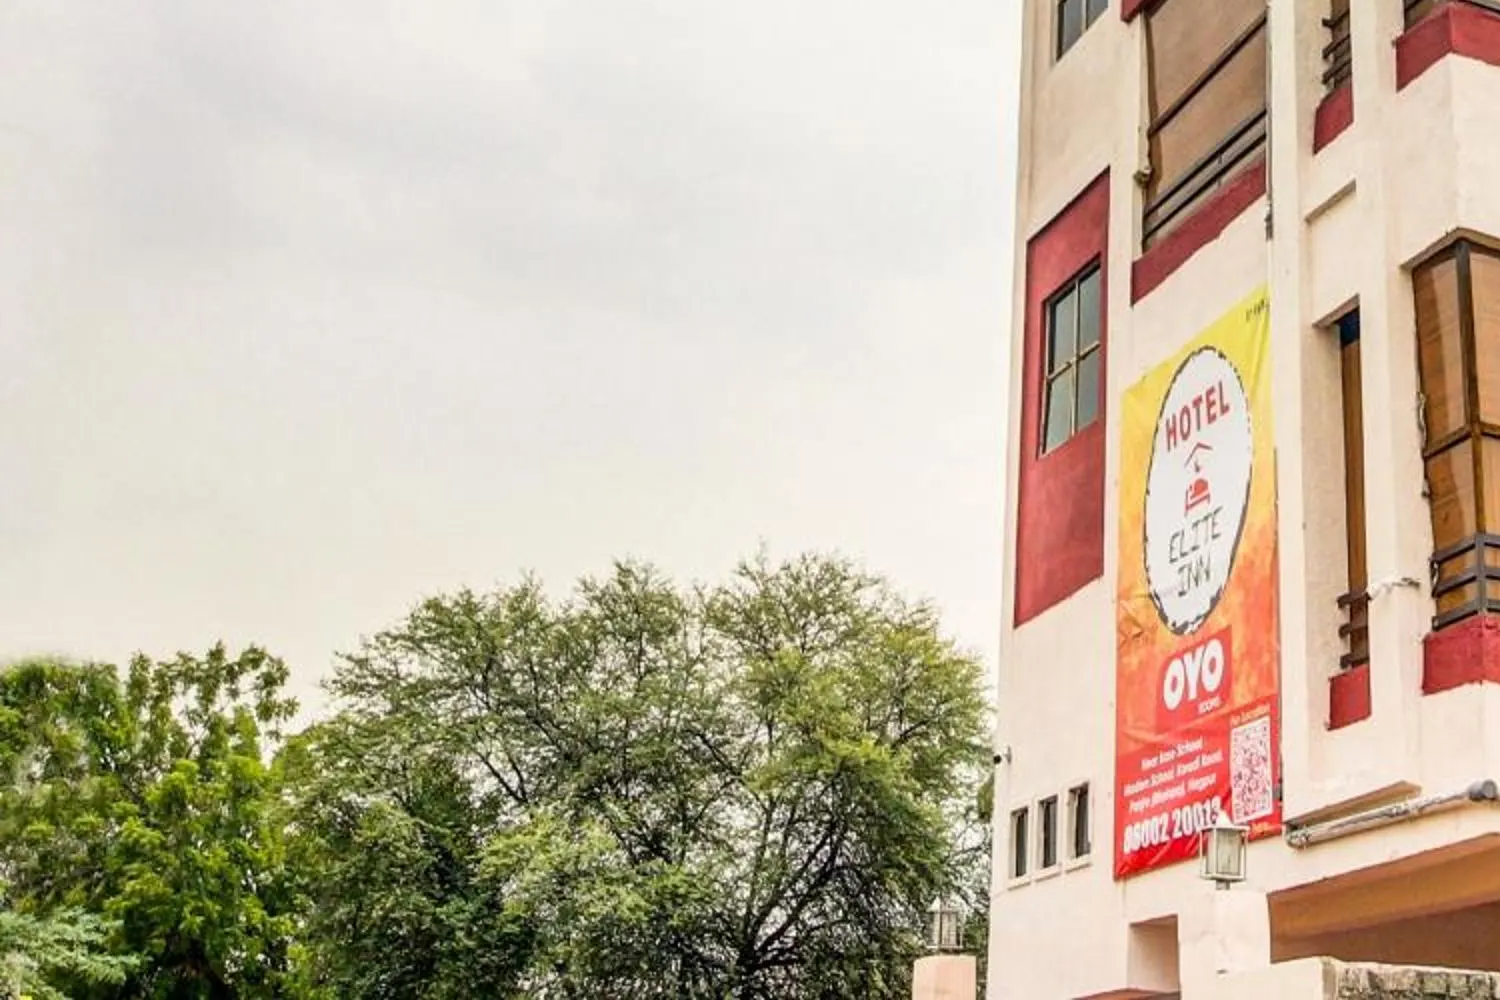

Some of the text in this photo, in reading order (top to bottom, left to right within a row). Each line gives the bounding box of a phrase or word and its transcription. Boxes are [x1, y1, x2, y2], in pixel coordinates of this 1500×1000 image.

[1165, 380, 1230, 451] HOTEL
[1168, 506, 1224, 564] ELITE
[1176, 556, 1212, 598] INN
[1163, 638, 1225, 711] OYO
